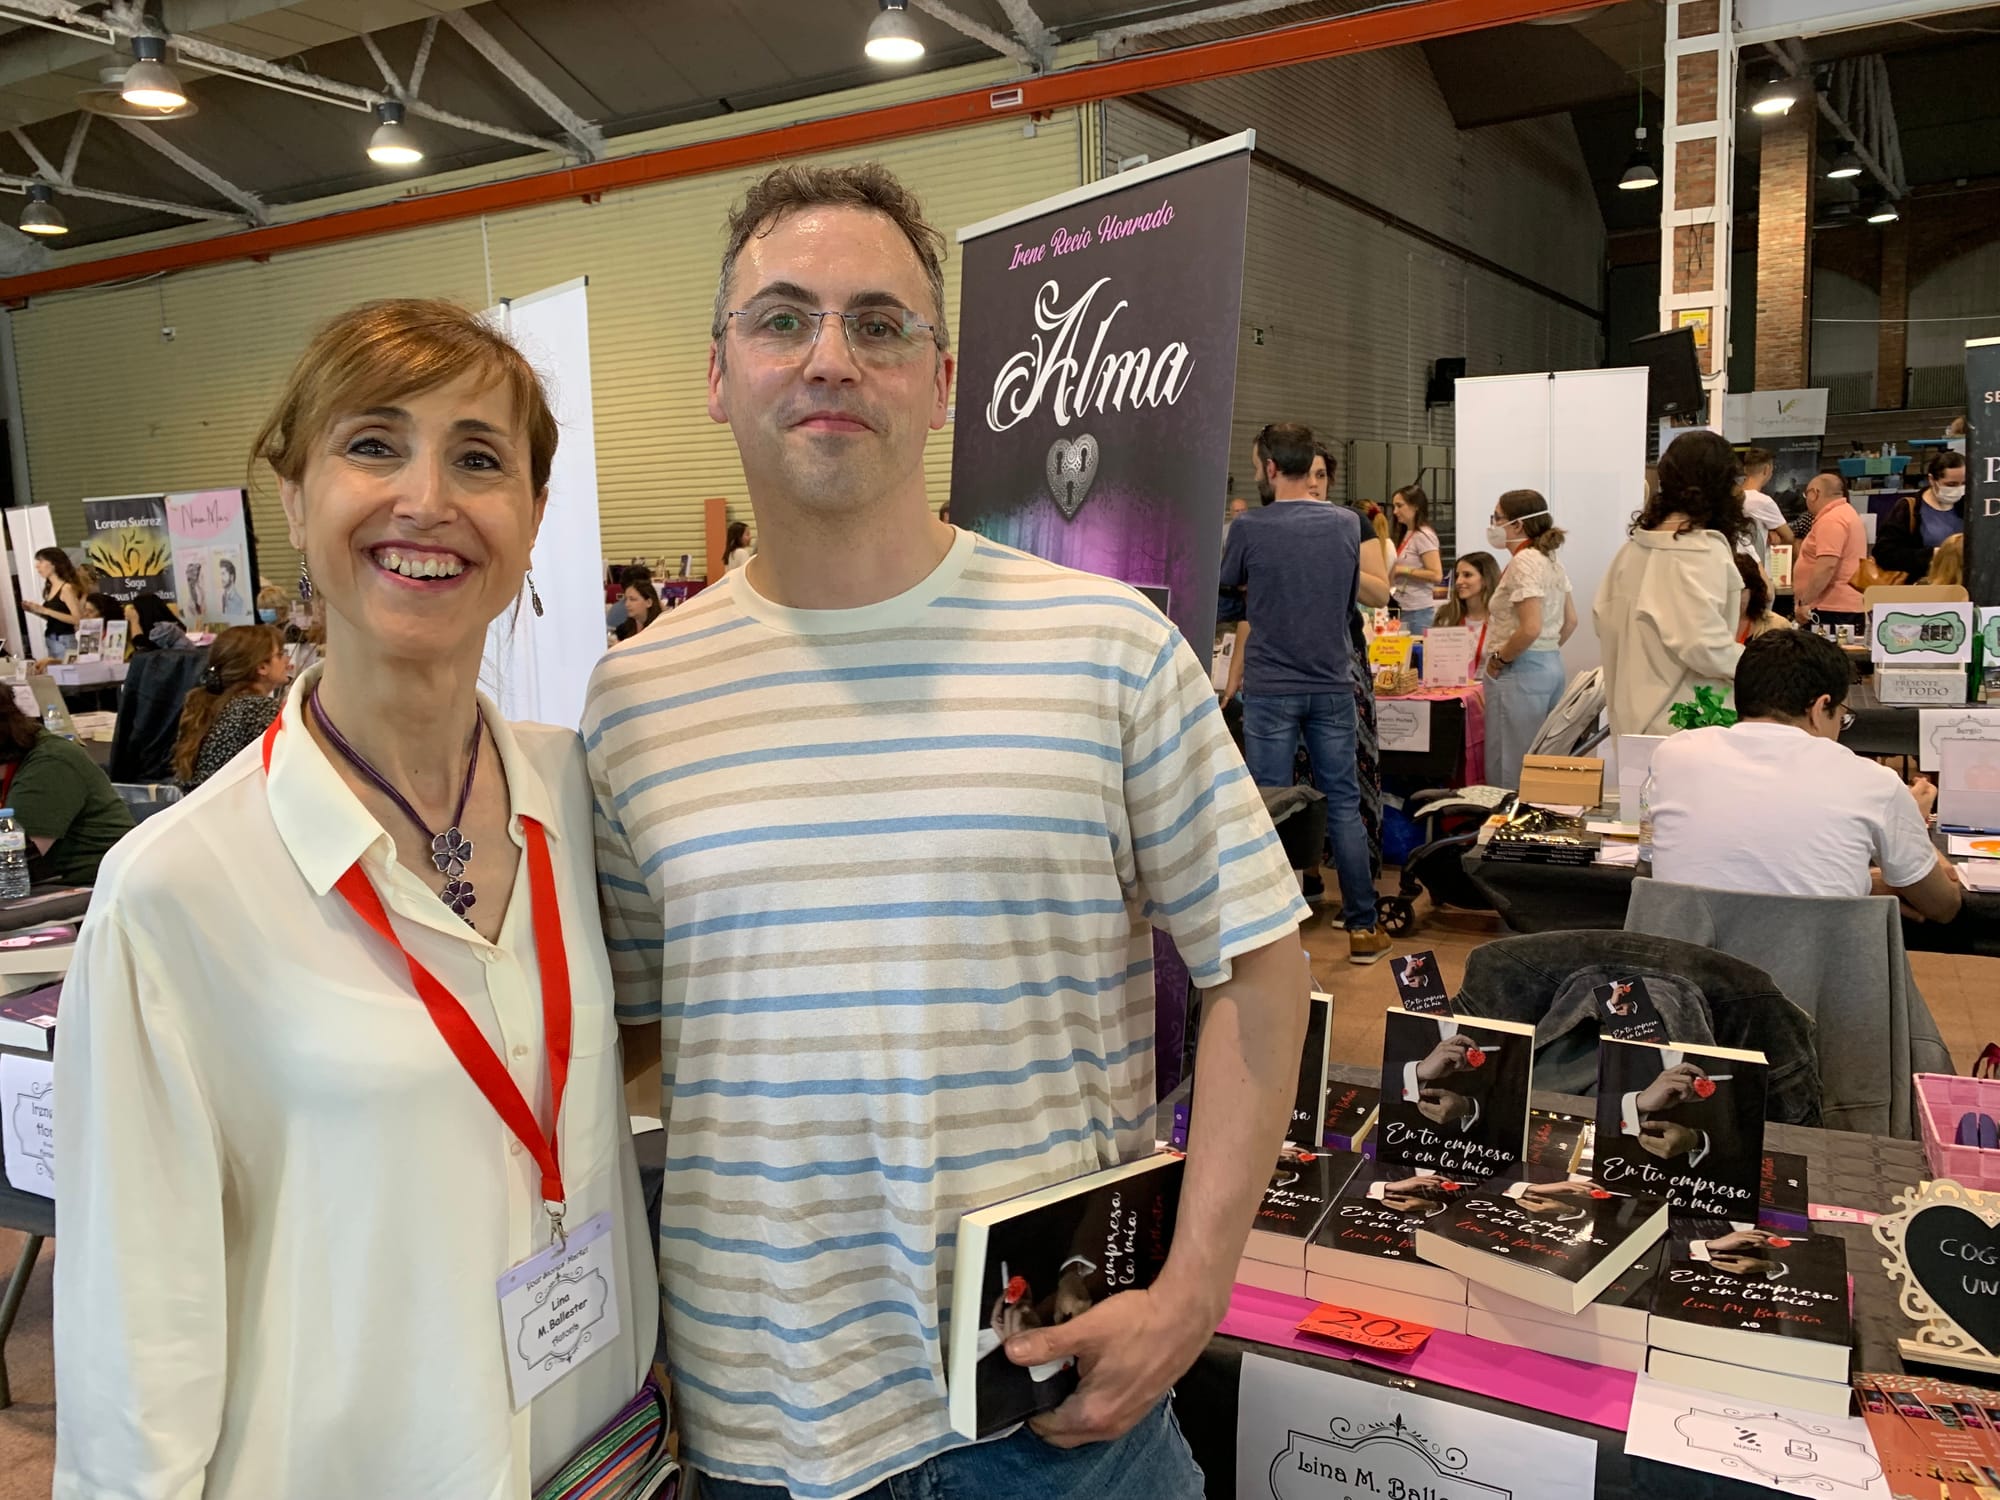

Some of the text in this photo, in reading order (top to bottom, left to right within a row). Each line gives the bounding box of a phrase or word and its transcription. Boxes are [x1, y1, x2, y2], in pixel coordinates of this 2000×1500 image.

[1008, 200, 1175, 270] Irene Recio Honrado
[985, 277, 1196, 432] Alma
[94, 516, 161, 530] Lorena Suárez
[124, 578, 147, 590] Saga
[1908, 687, 1949, 696] TODO
[1386, 1122, 1417, 1144] En
[1417, 1128, 1441, 1145] tu
[1443, 1138, 1514, 1161] empresa
[1402, 1150, 1494, 1176] o en la mía
[1602, 1157, 1751, 1200] En tu empresa
[1265, 1187, 1325, 1203] mpresa
[1267, 1197, 1300, 1208] mía
[1666, 1189, 1686, 1208] la
[1690, 1198, 1728, 1216] mía
[1257, 1210, 1297, 1220] llester
[1340, 1205, 1401, 1220] En tu
[1465, 1199, 1502, 1213] En
[1503, 1207, 1528, 1221] tu
[1104, 1191, 1123, 1286] empresa
[1341, 1228, 1370, 1240] Lina
[1368, 1221, 1392, 1229] en
[1396, 1223, 1416, 1233] la
[1455, 1219, 1486, 1233] Lina
[1511, 1238, 1569, 1260] Ballester
[1490, 1217, 1514, 1227] en
[1517, 1223, 1540, 1235] la
[1541, 1232, 1578, 1247] mía
[1119, 1211, 1137, 1284] la mía
[1939, 1238, 1999, 1265] COG
[1670, 1269, 1840, 1301] En tu empresa
[1691, 1284, 1814, 1307] o en la mía
[1962, 1274, 2000, 1296] UN
[551, 1294, 570, 1311] Lina
[1682, 1297, 1718, 1310] Lina
[1754, 1307, 1823, 1324] Ballester
[537, 1326, 550, 1339] M.
[549, 1298, 588, 1330] Ballester
[1318, 1310, 1426, 1343] 20€
[1298, 1451, 1449, 1500] Lina M. Ball
